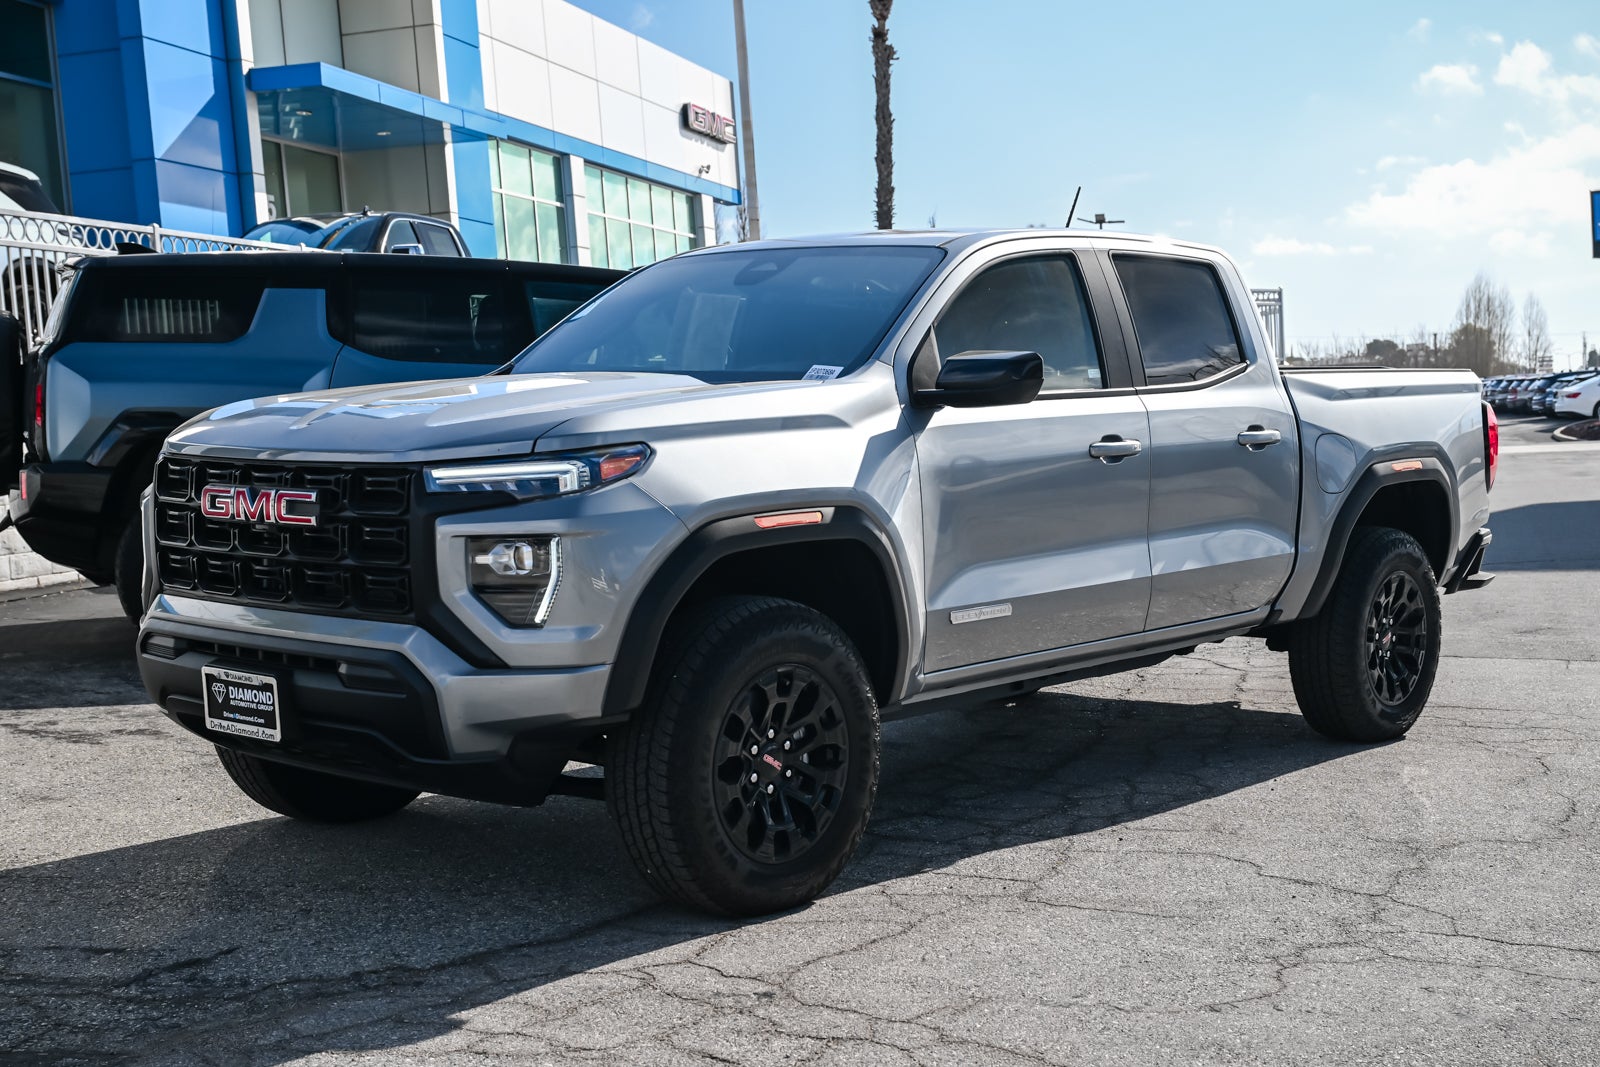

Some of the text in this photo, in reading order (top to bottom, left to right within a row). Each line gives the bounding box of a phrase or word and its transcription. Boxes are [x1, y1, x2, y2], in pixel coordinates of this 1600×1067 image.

[689, 103, 737, 144] GMC
[201, 485, 317, 526] GMC
[229, 673, 254, 683] DIAMOND
[228, 686, 274, 705] DIAMOND
[230, 699, 274, 712] AUTOMOTIVE GROUP
